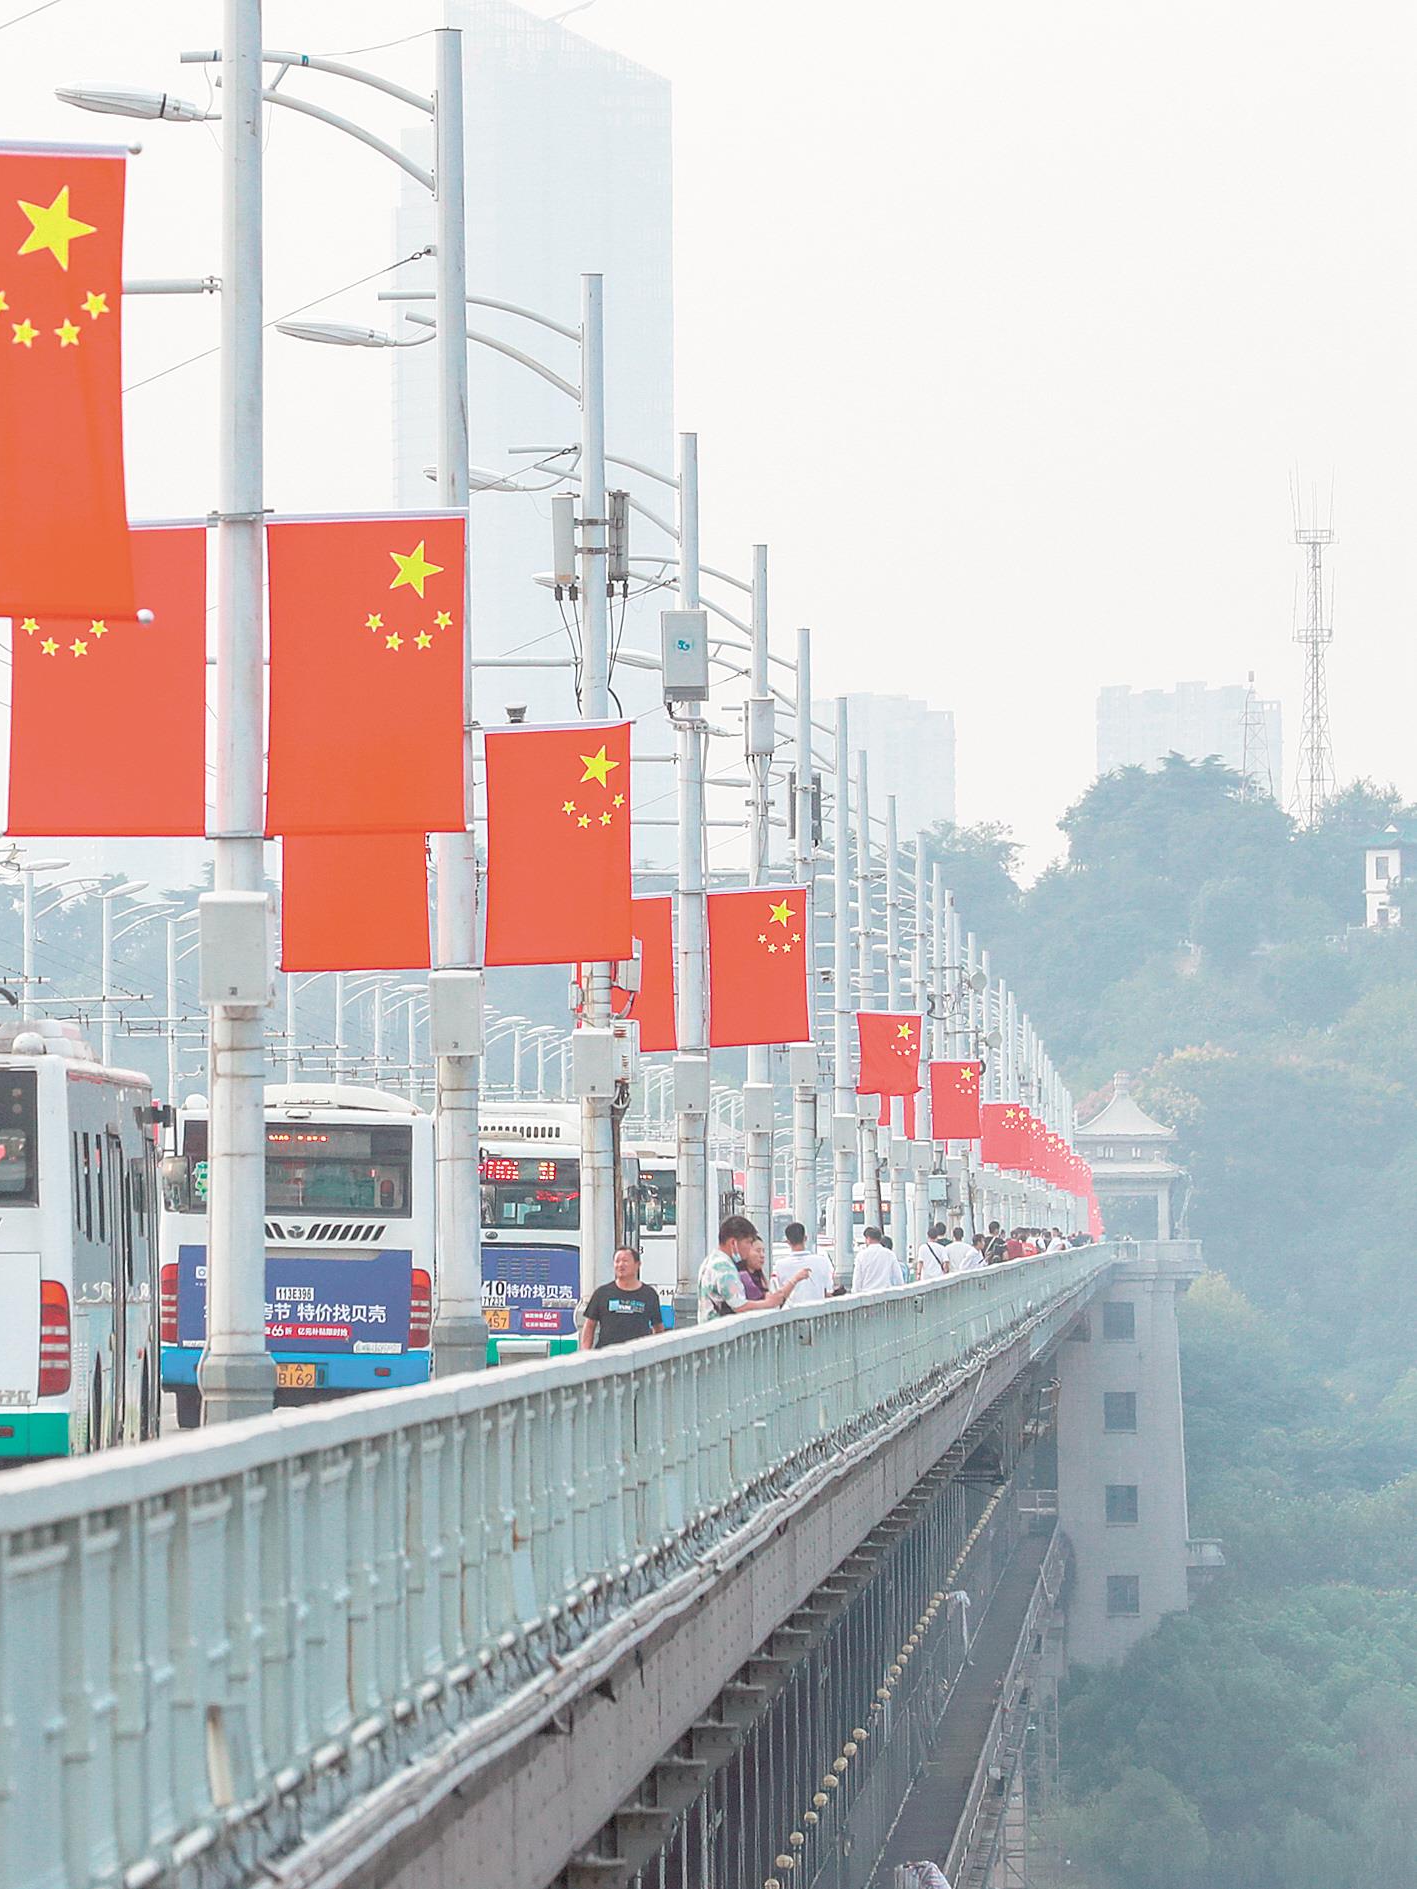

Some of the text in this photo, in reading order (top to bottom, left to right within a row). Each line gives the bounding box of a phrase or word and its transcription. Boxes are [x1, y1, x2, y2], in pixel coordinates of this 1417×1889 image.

[506, 1283, 573, 1299] 特价找贝壳
[297, 1303, 387, 1323] 特价找贝壳
